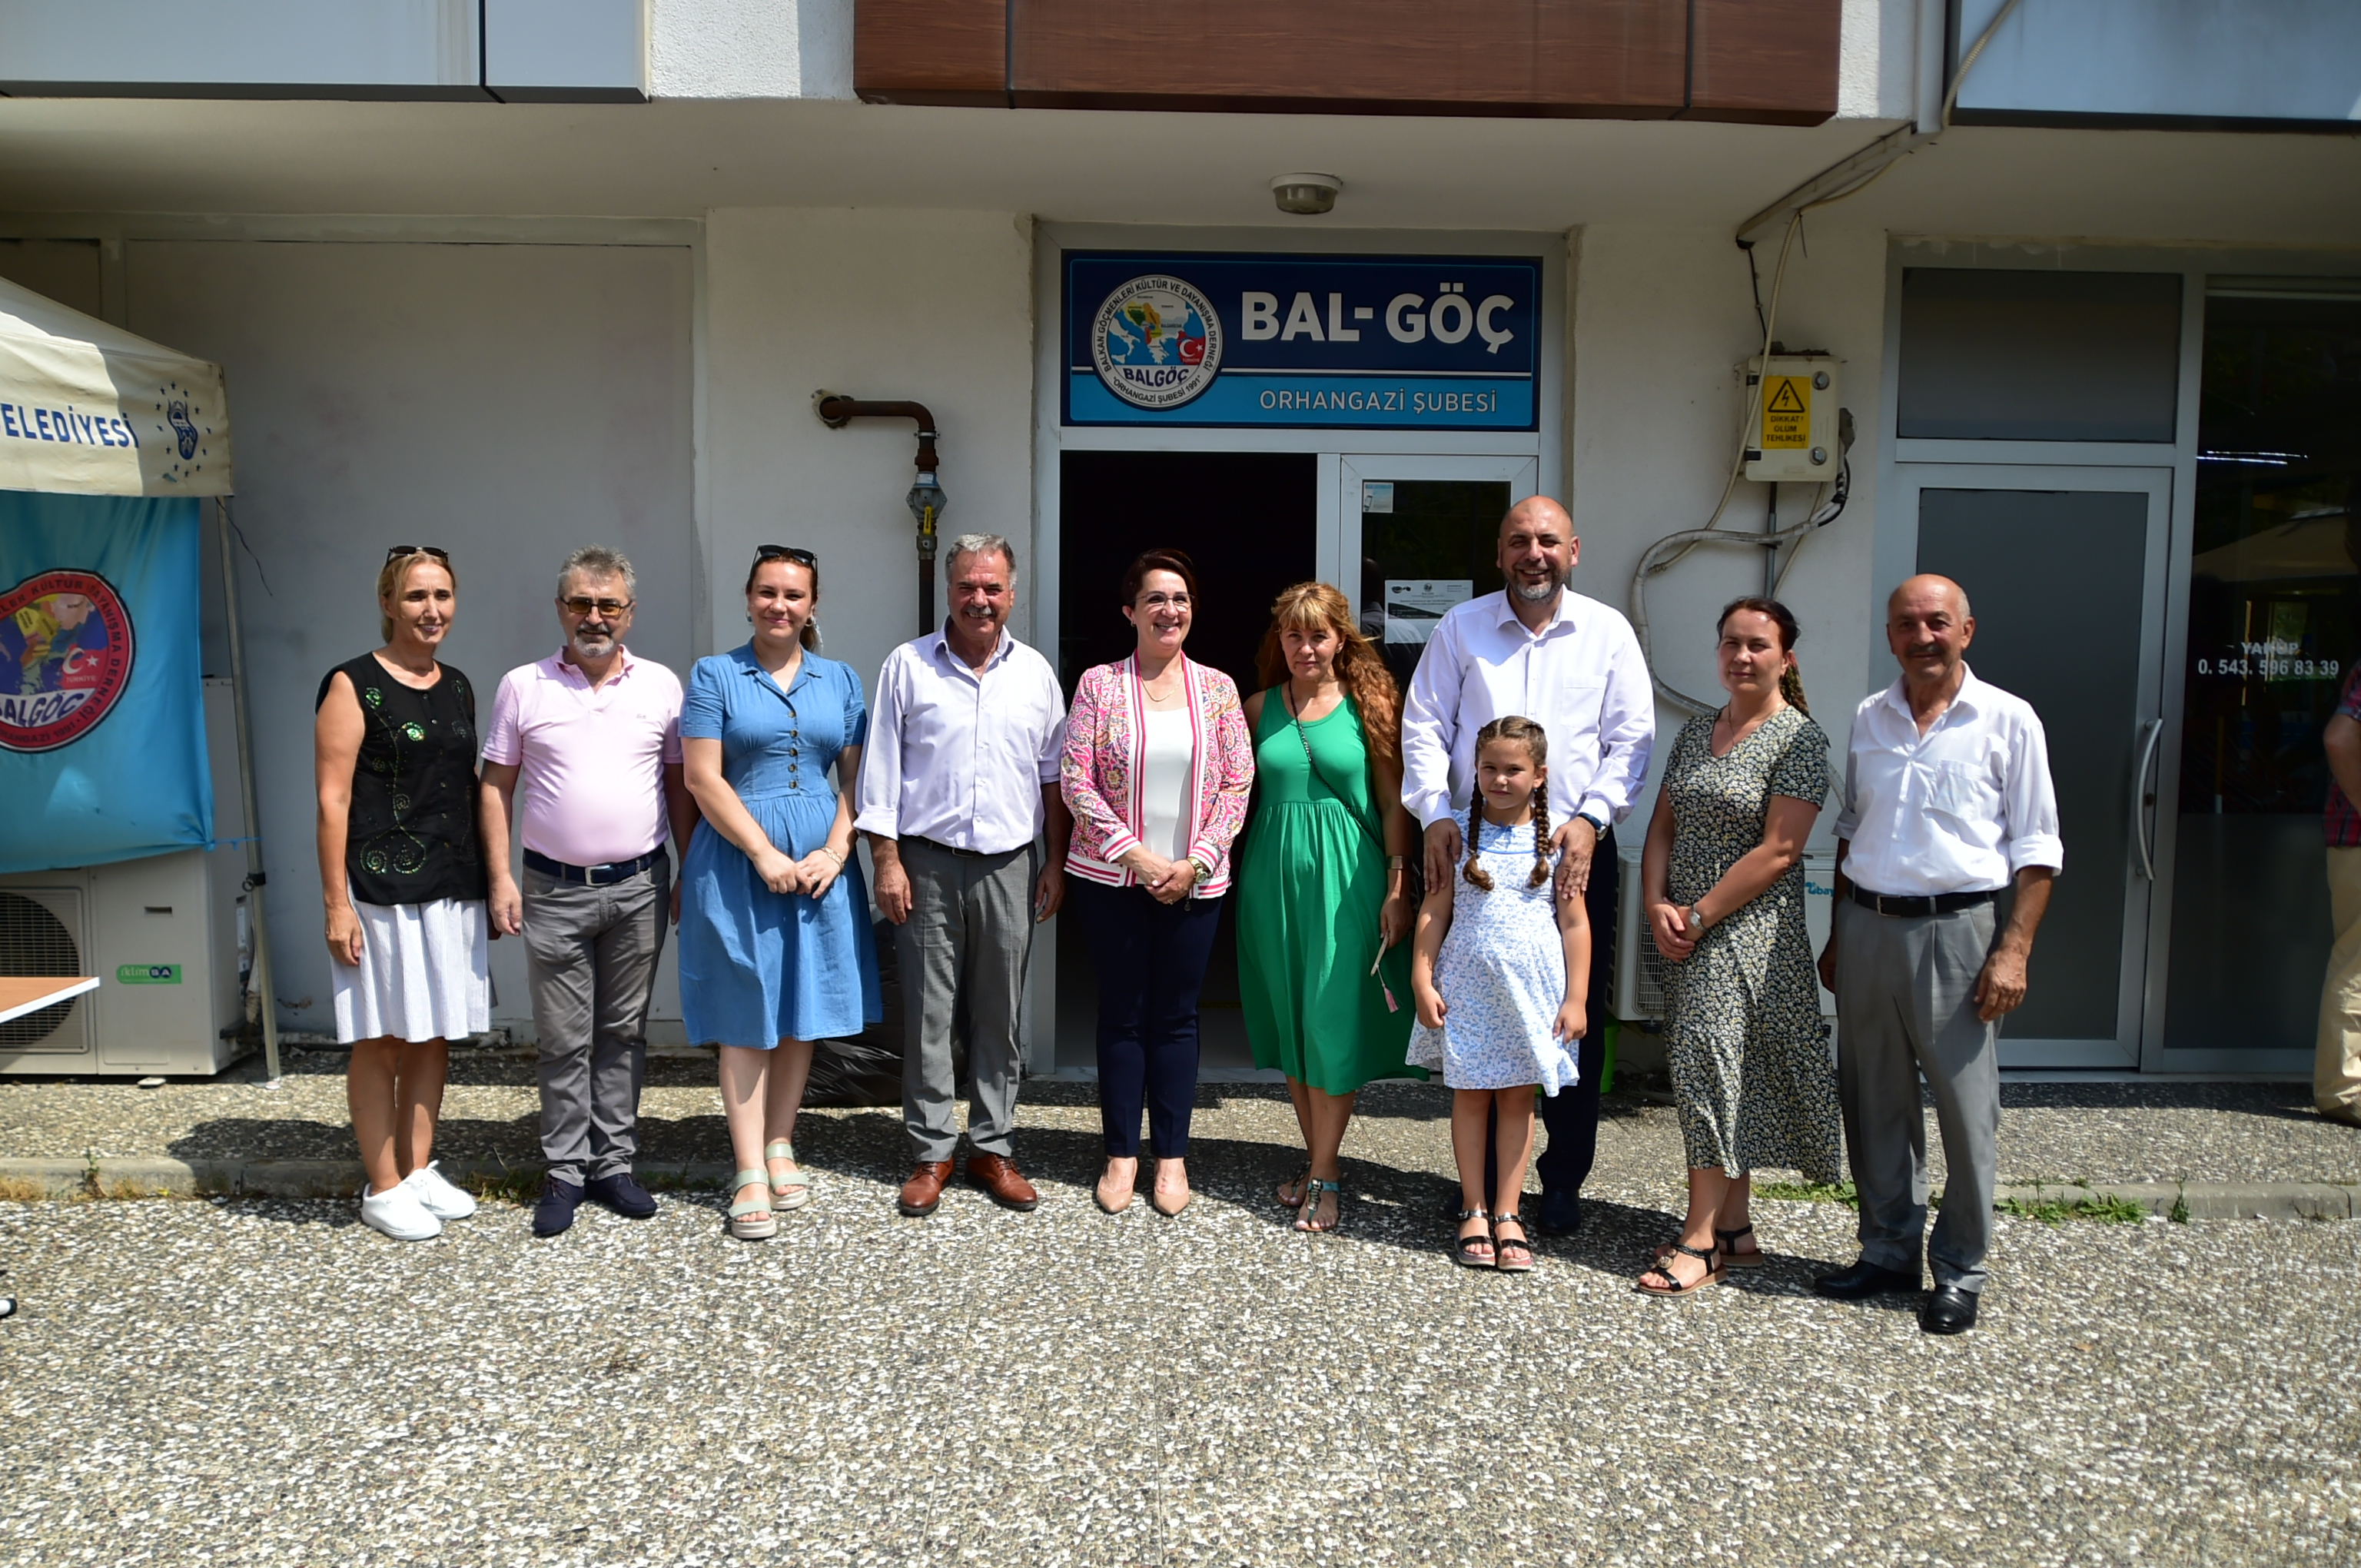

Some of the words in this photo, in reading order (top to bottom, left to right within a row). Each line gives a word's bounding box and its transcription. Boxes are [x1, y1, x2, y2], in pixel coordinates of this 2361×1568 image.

[1097, 336, 1112, 373] BALKAN
[1135, 278, 1167, 291] KÜLTÜR
[1170, 281, 1181, 292] VE
[1180, 287, 1215, 331] DAYANIŞMA
[1203, 331, 1217, 372] DERNEĞİ
[1122, 366, 1190, 387] BALGÖÇ
[1157, 387, 1185, 404] ŞUBESİ
[1260, 387, 1405, 411] ORHANGAZİ
[1413, 389, 1496, 414] ŞUBESİ
[0, 402, 139, 448] ELEDİYESİ
[2218, 659, 2253, 675] 543.
[2259, 659, 2289, 676] 596
[2294, 659, 2314, 676] 83
[2319, 659, 2339, 676] 39
